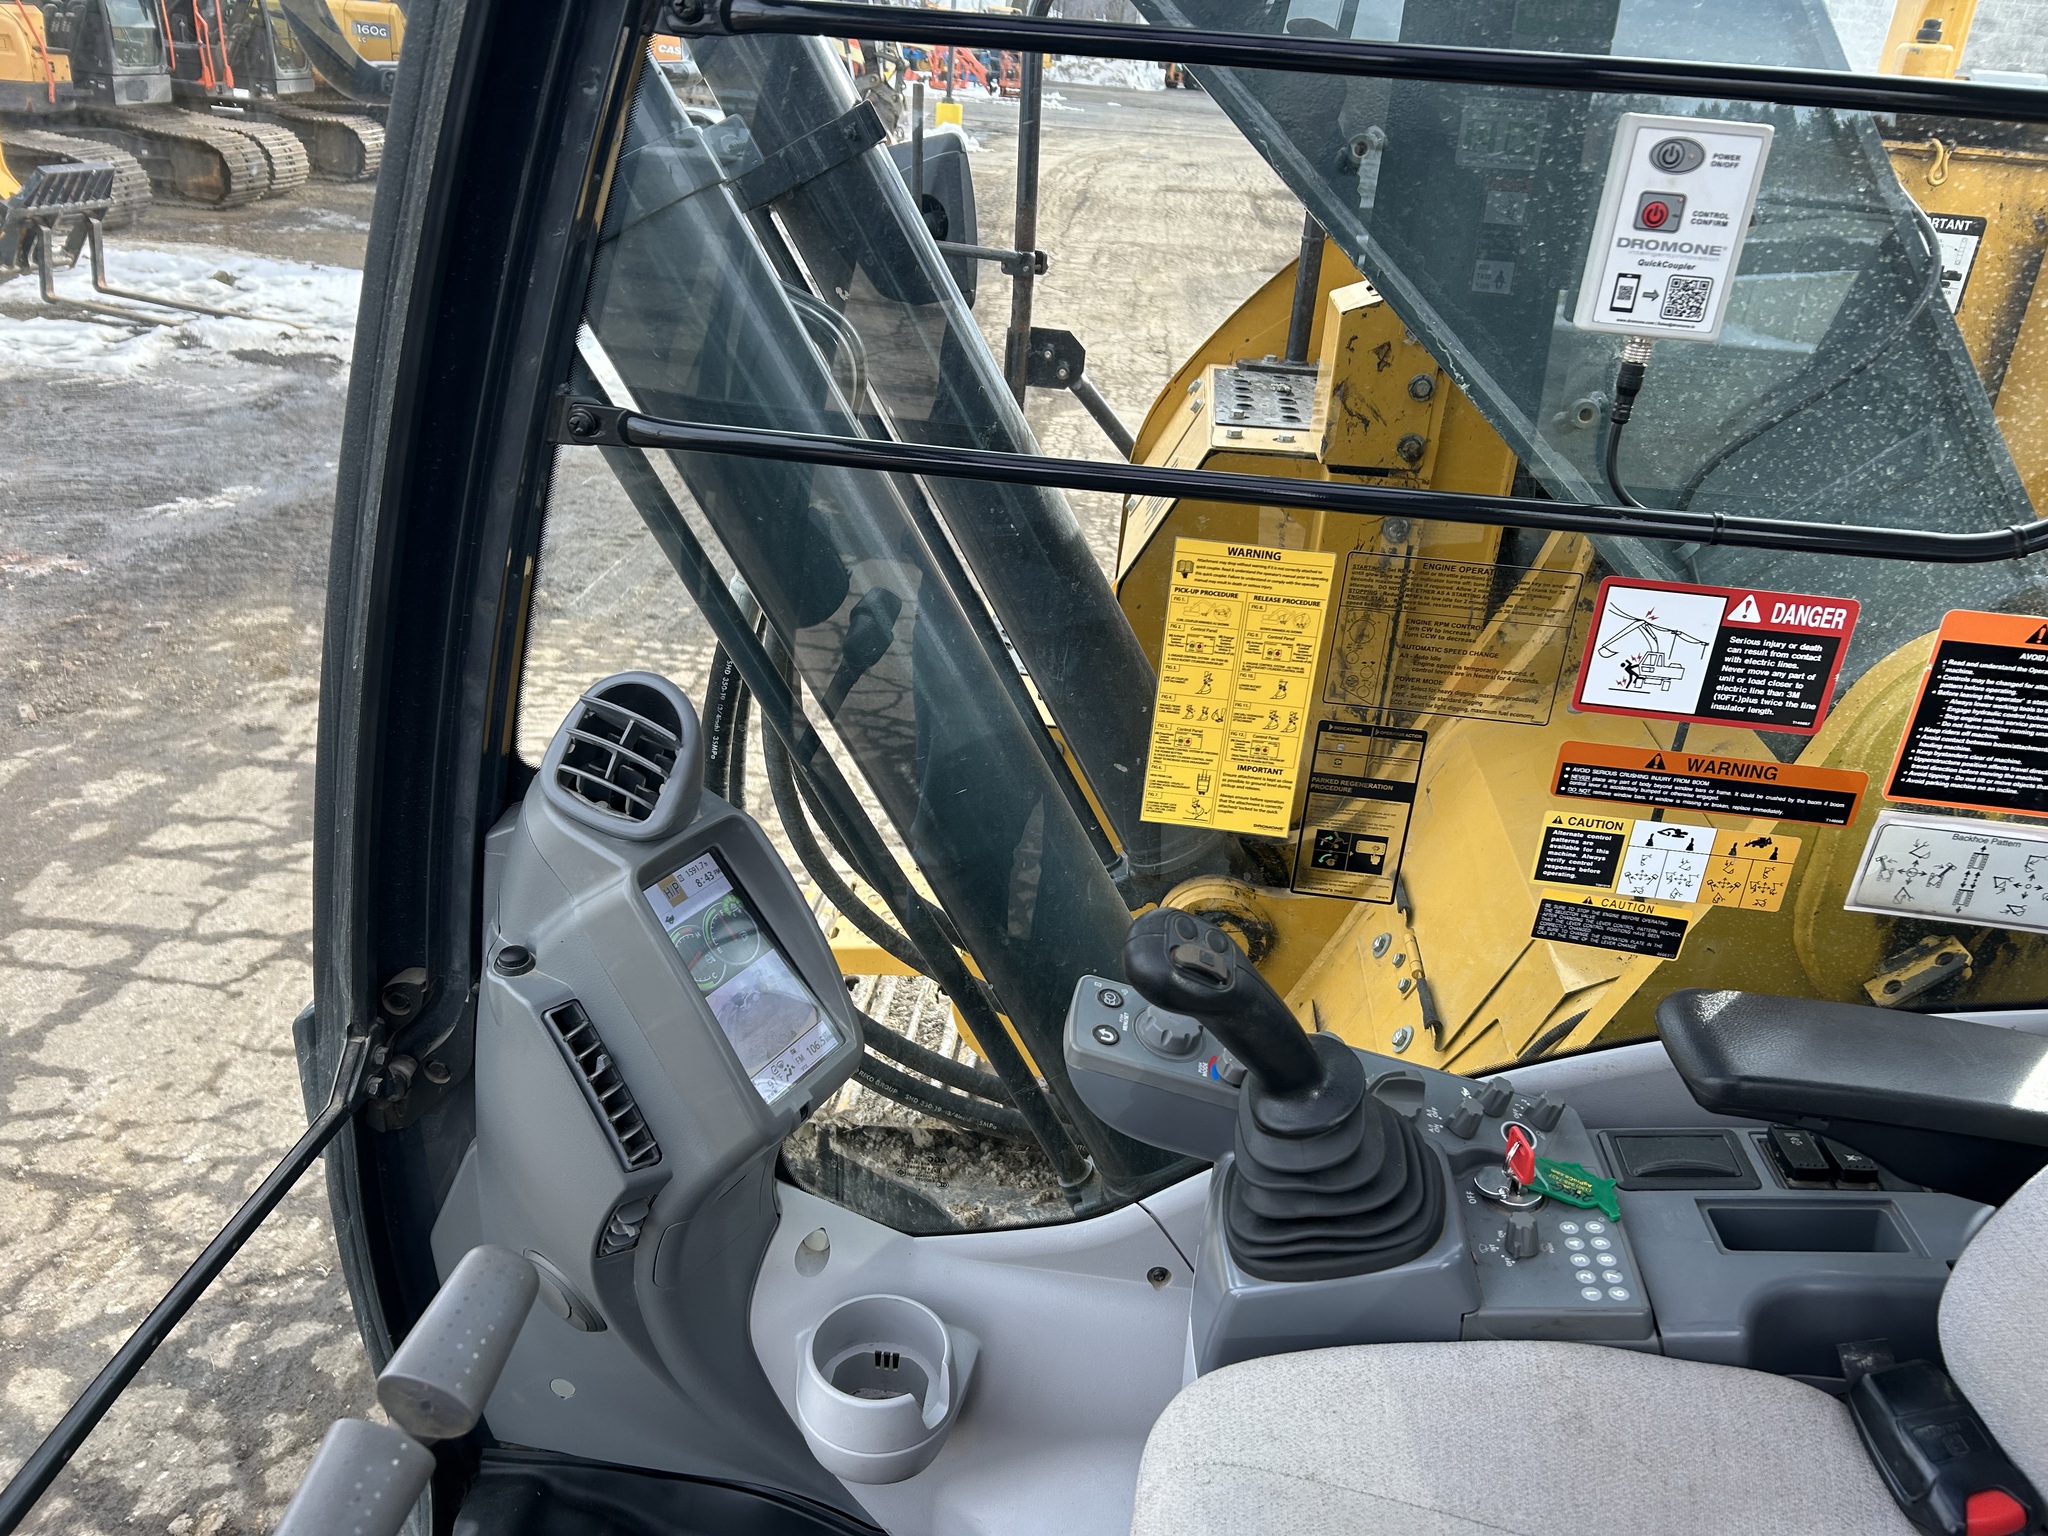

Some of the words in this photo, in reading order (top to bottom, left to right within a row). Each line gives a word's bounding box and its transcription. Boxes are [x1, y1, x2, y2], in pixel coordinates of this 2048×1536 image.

[356, 24, 387, 36] 160G
[658, 44, 682, 55] CAS
[1692, 210, 1728, 219] CONTROL
[1690, 218, 1728, 226] CONFIRM
[1930, 218, 1973, 231] RTANT
[1616, 237, 1722, 255] DROMONE
[1637, 259, 1695, 270] QuickCoupler
[1227, 546, 1281, 560] WARNING
[1422, 562, 1456, 571] ENGINE
[1458, 566, 1495, 576] OPERAT
[1200, 589, 1238, 598] PROCEDURE
[1282, 598, 1320, 606] PROCEDURE
[1770, 602, 1846, 629] DANGER
[1445, 635, 1476, 643] decrease
[1729, 636, 1760, 645] Serious
[1762, 639, 1786, 648] injury
[1400, 643, 1442, 652] AUTOMATIC
[1468, 650, 1499, 658] CHANGE
[1721, 664, 1745, 672] Never
[1744, 657, 1775, 666] electric
[1777, 660, 1798, 668] lines.
[1716, 684, 1747, 692] electric
[1710, 702, 1745, 711] insulator
[1747, 706, 1773, 714] length.
[1760, 698, 1782, 706] twice
[1237, 764, 1283, 774] IMPORTANT
[1688, 758, 1777, 780] WARNING
[1310, 783, 1352, 792] PROCEDURE
[1340, 780, 1393, 790] REGENERATION
[1568, 816, 1623, 830] CAUTION
[1952, 834, 1989, 843] Backhoe
[1991, 838, 2021, 847] Pattern
[696, 872, 715, 888] 8:43
[663, 882, 680, 899] H/P
[1601, 898, 1654, 913] CAUTION
[795, 1055, 805, 1065] FM
[806, 1036, 826, 1056] 106.5
[1466, 1191, 1477, 1204] OFF
